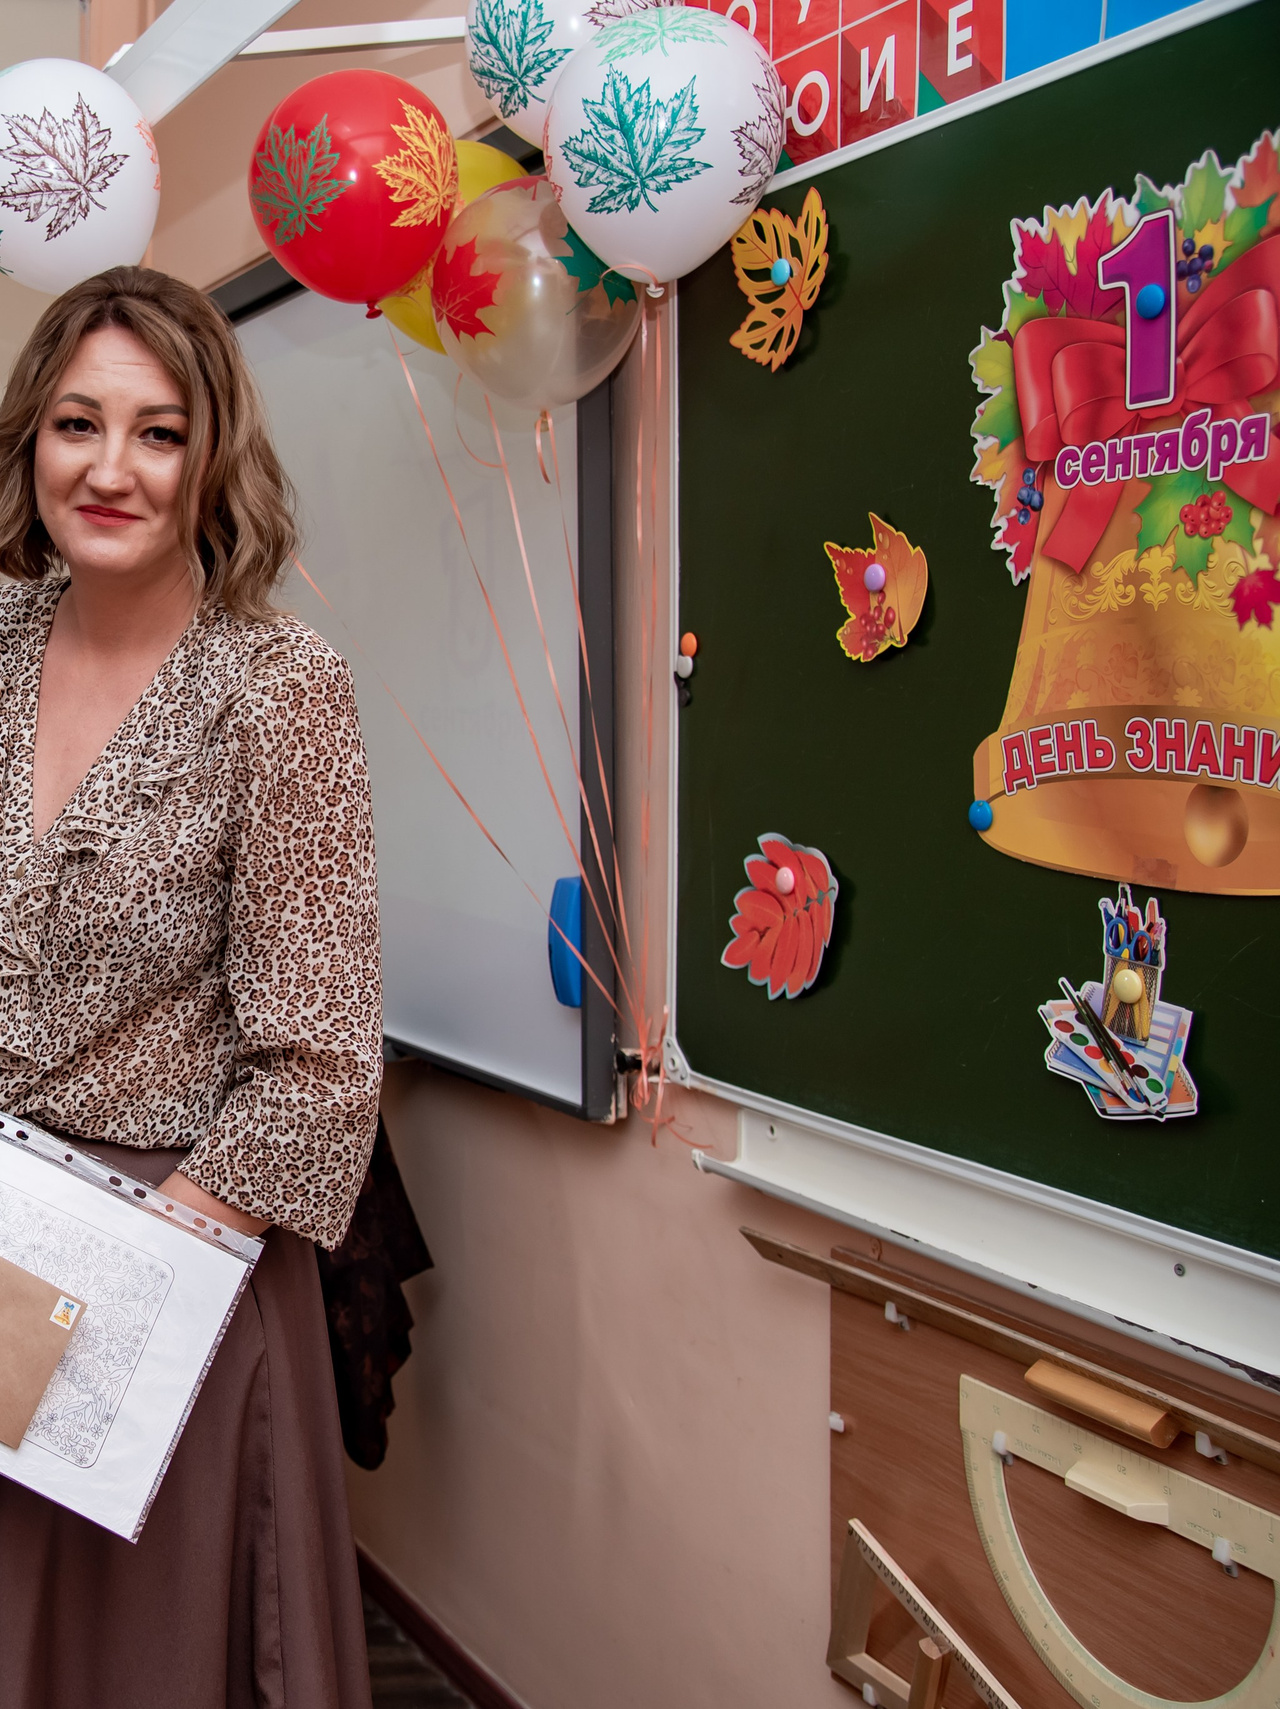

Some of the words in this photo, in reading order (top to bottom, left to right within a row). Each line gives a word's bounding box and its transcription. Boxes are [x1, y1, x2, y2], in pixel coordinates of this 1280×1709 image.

[1099, 209, 1175, 410] 1
[1055, 408, 1270, 488] сентября
[1001, 719, 1116, 795] ДЕНЬ
